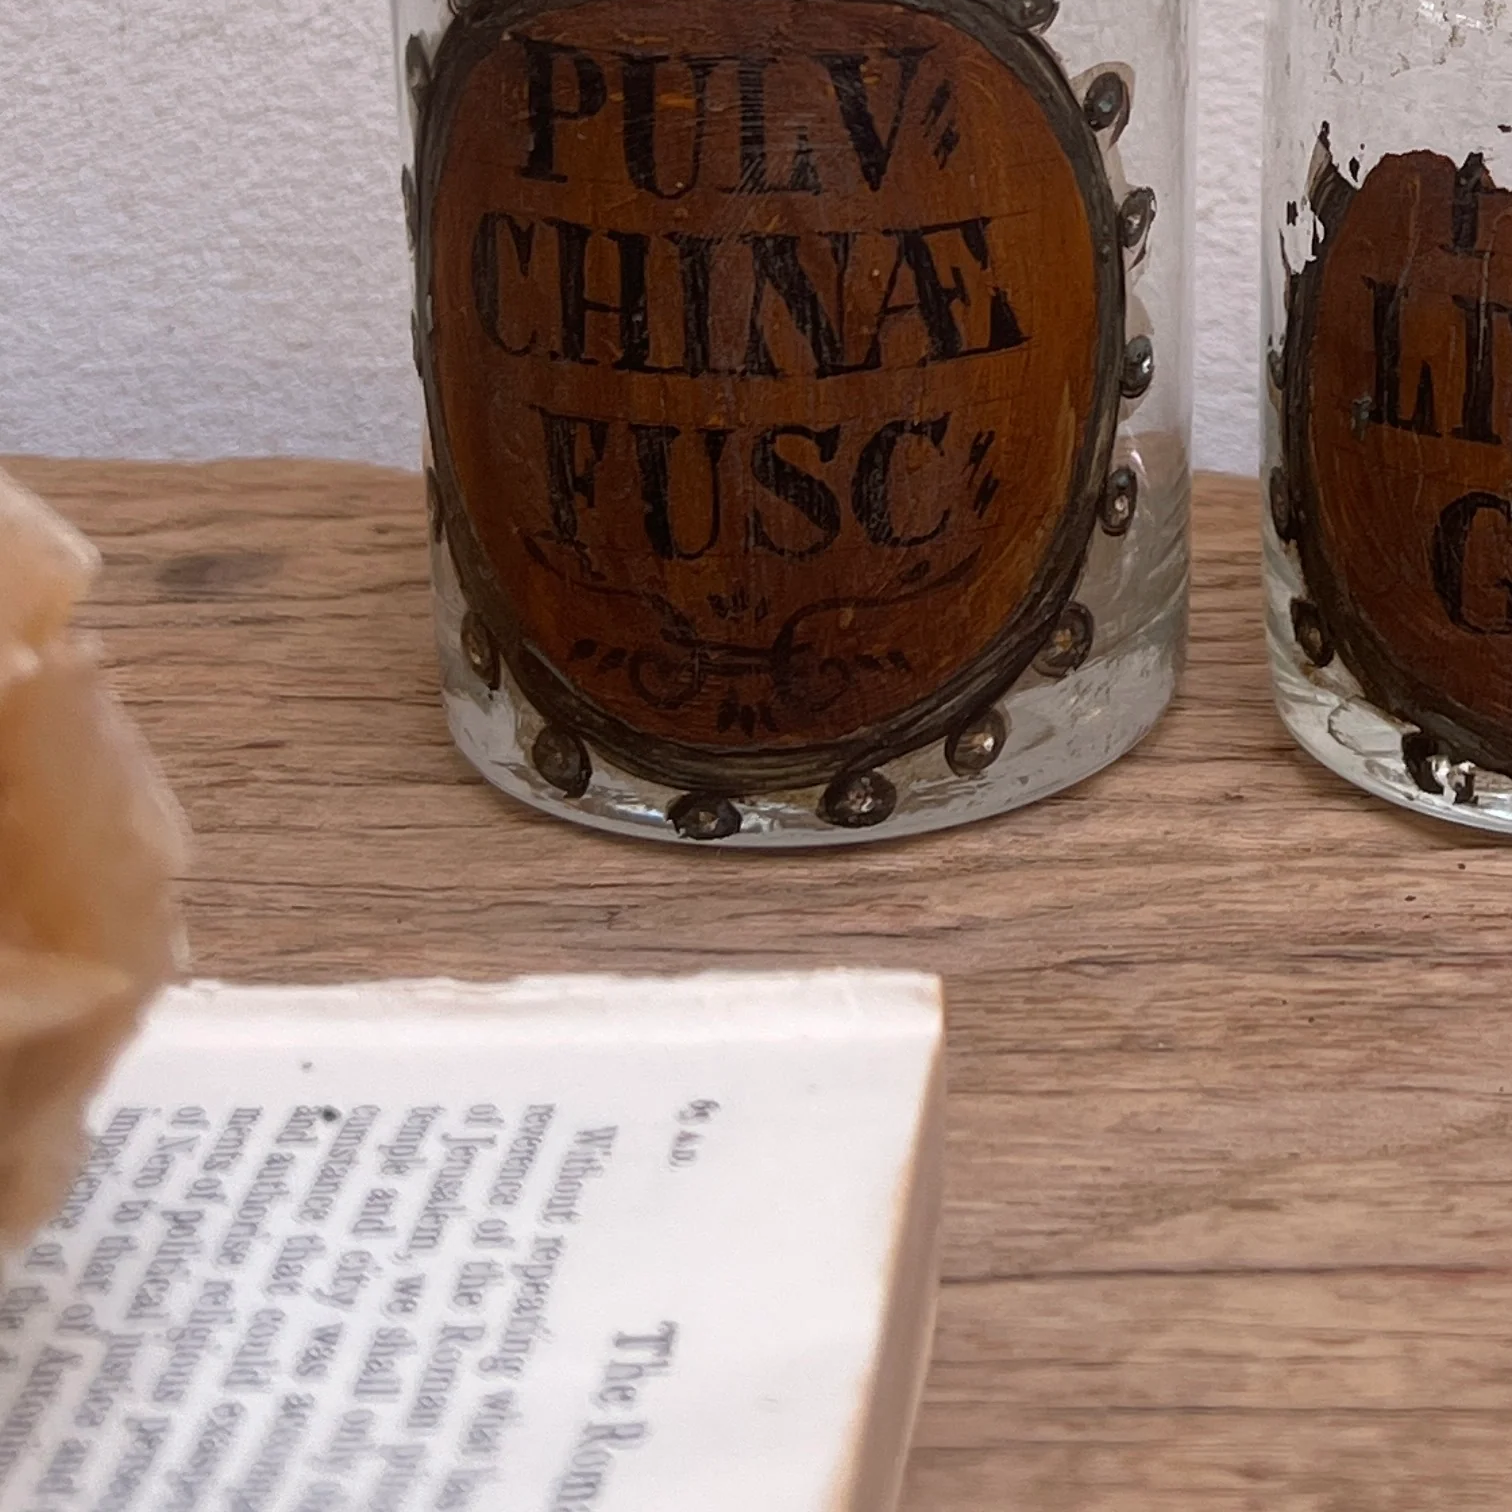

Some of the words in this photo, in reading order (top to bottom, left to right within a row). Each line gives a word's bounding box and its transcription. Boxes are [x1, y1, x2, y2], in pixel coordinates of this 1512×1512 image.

[168, 1105, 211, 1130] of
[200, 1106, 264, 1175] ments
[273, 1104, 327, 1148] and
[376, 1104, 446, 1177] temple
[463, 1103, 505, 1129] of
[58, 1106, 160, 1230] impatience
[131, 1134, 200, 1191] Nero
[183, 1175, 228, 1205] of
[296, 1104, 382, 1222] cumstance
[488, 1103, 556, 1207] reverence
[541, 1125, 619, 1224] Without
[110, 1198, 157, 1227] to
[215, 1152, 296, 1266] authorise
[349, 1187, 399, 1238] and
[393, 1132, 497, 1262] Jerusalem,
[470, 1218, 516, 1249] of
[23, 1242, 68, 1276] of
[74, 1234, 139, 1296] that
[123, 1208, 206, 1322] political
[262, 1233, 327, 1297] that
[310, 1249, 383, 1311] city
[385, 1273, 426, 1315] we
[451, 1259, 516, 1308] the
[53, 1303, 100, 1338] of
[150, 1278, 237, 1406] religious
[477, 1235, 565, 1379] repeating
[72, 1328, 163, 1429] justice
[220, 1307, 287, 1392] could
[292, 1322, 344, 1380] was
[351, 1326, 418, 1403] shall
[404, 1321, 487, 1434] Roman
[595, 1320, 679, 1408] The
[0, 1343, 84, 1470] Antonin
[94, 1415, 171, 1512] perse
[225, 1392, 316, 1512] accomp
